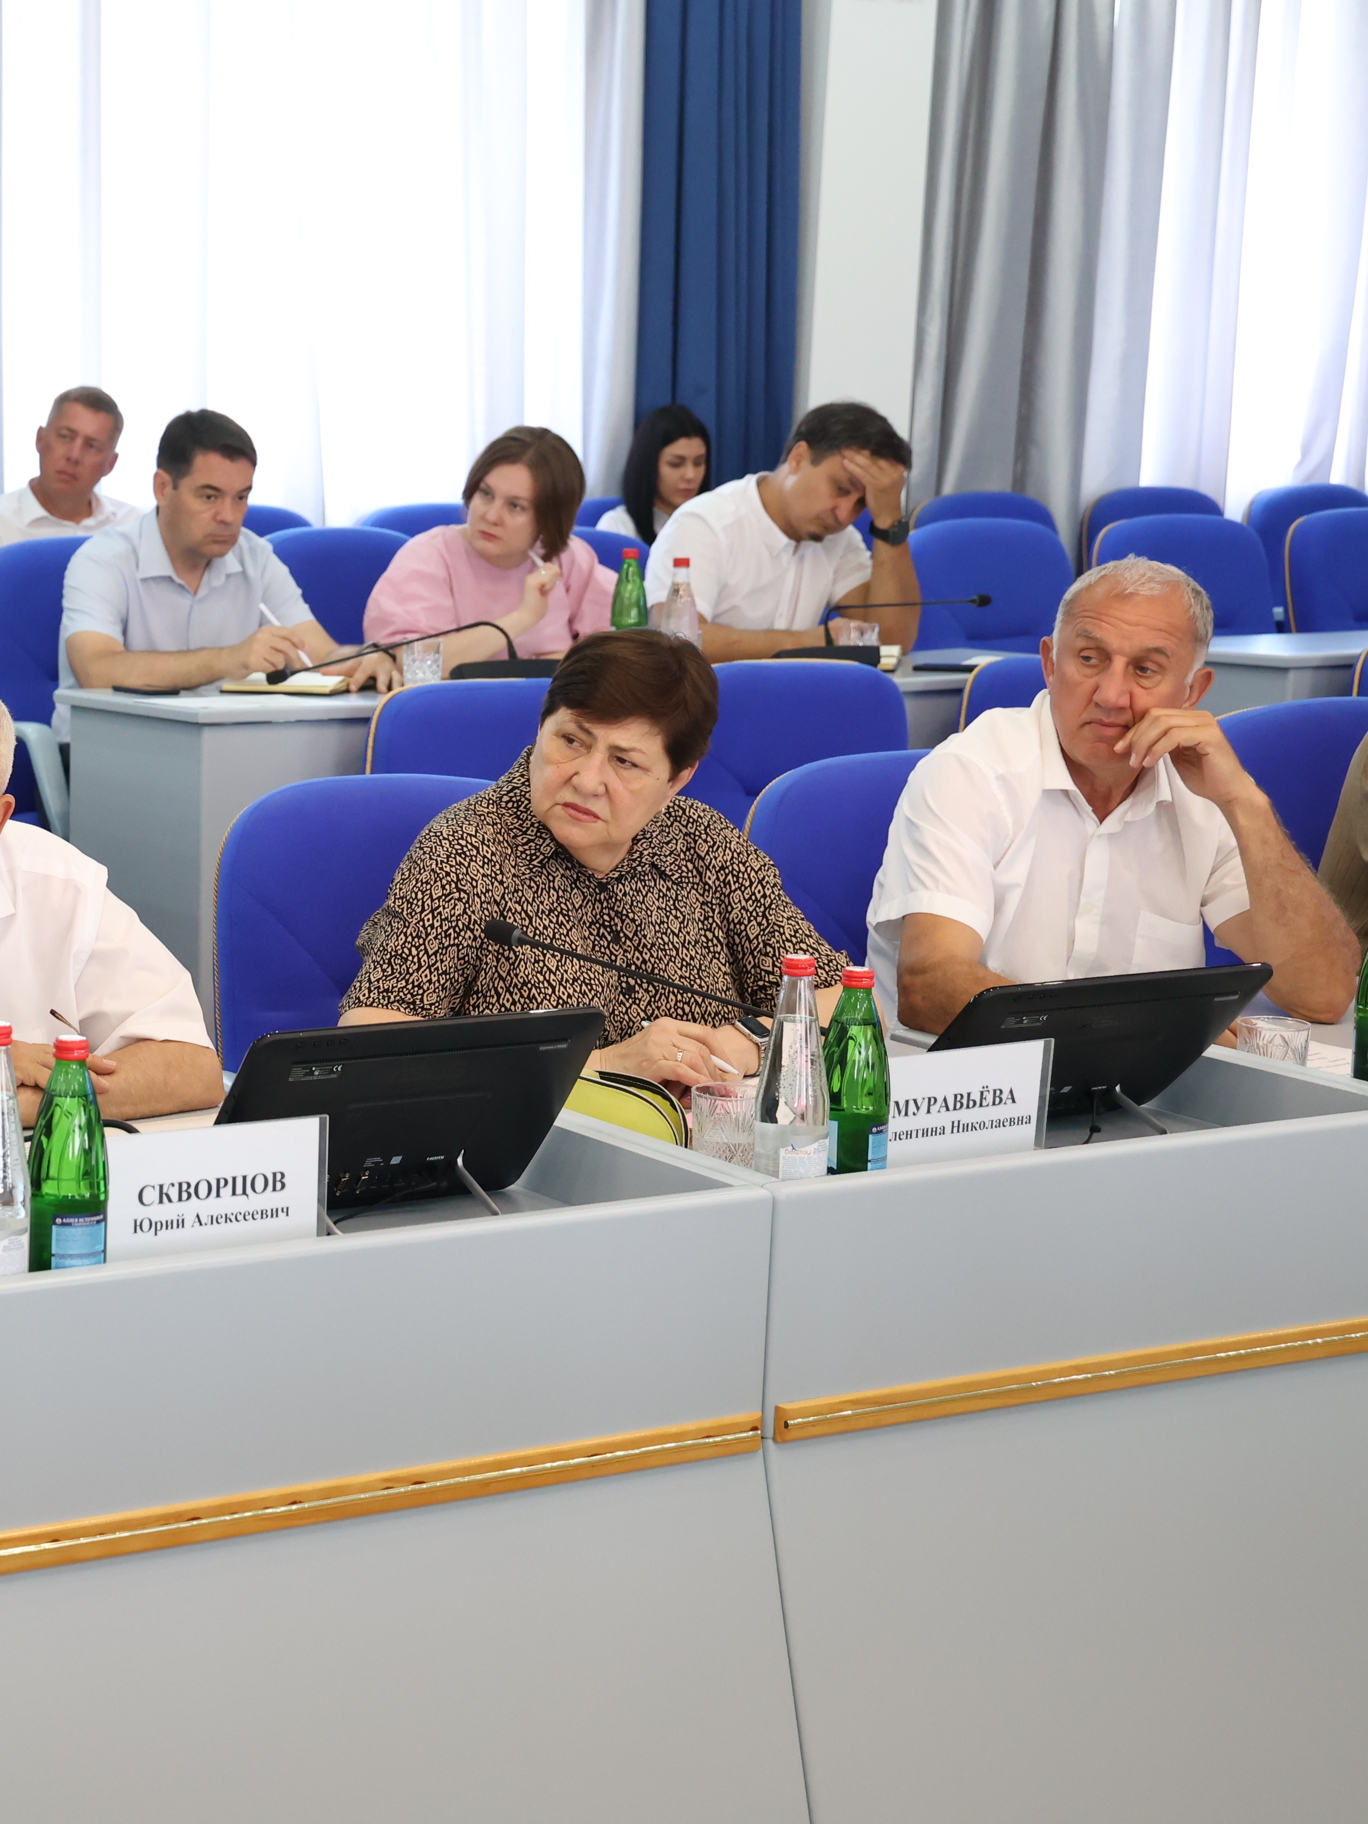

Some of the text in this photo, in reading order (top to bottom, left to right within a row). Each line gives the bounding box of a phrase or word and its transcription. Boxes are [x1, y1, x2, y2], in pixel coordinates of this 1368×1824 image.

[891, 1085, 1017, 1119] МУРАВЬЁВА
[888, 1114, 1032, 1142] лентина Николаевна
[137, 1171, 287, 1207] СКВОРЦОВ
[132, 1206, 290, 1236] Юрий Алексеевич
